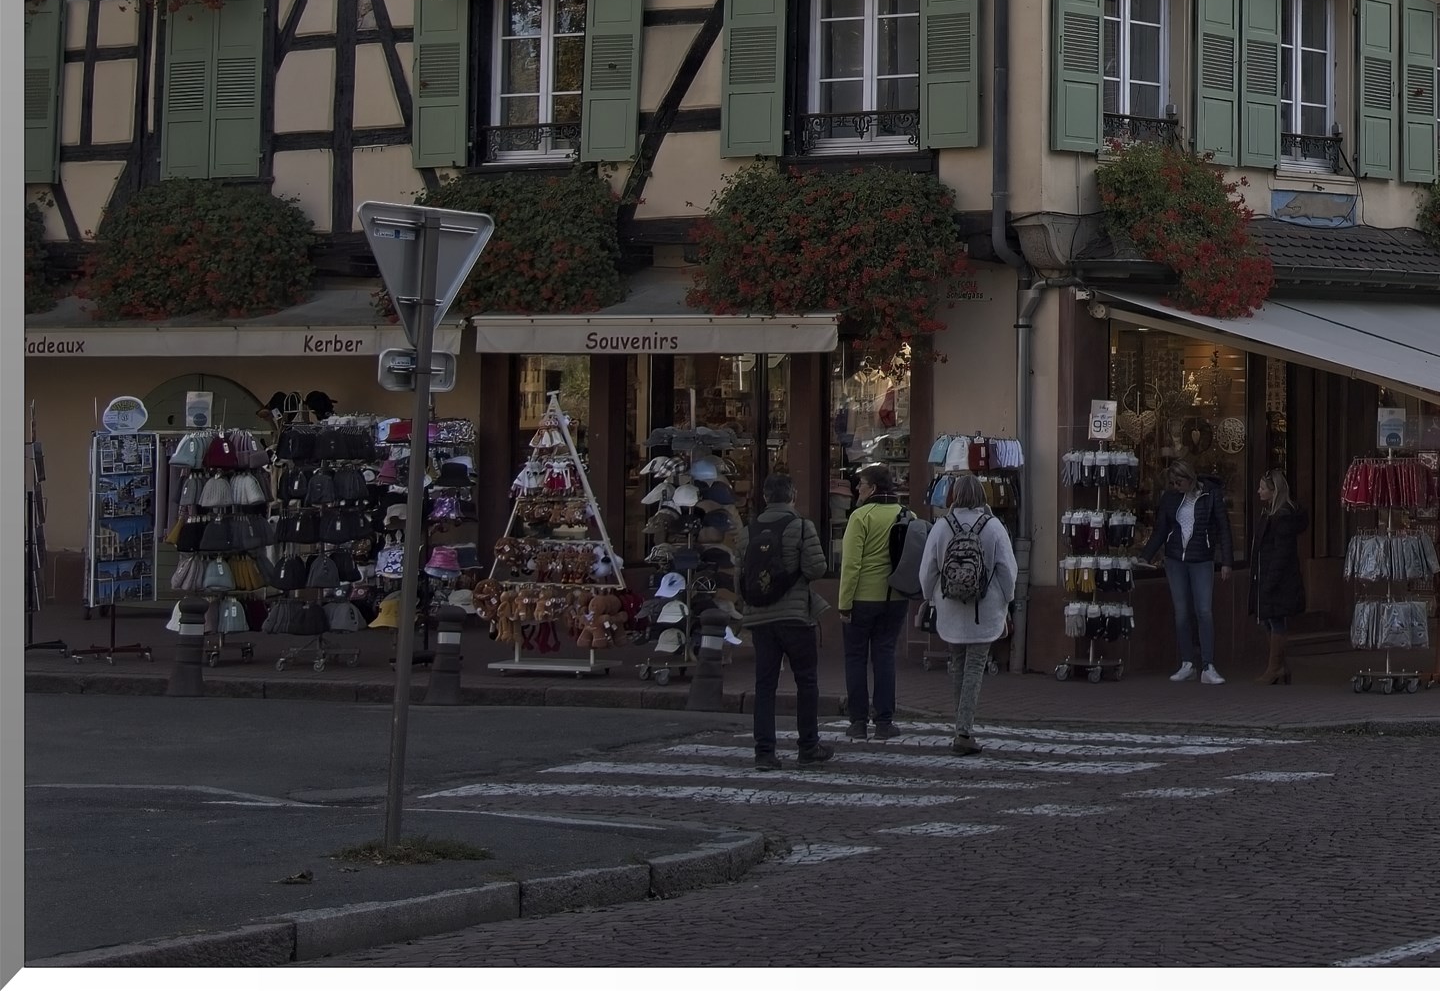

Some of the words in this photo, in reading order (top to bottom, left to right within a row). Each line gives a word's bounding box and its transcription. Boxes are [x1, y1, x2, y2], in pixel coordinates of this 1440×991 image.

[24, 336, 85, 353] adeaux
[304, 334, 363, 353] Kerber
[585, 331, 678, 350] Souvenirs
